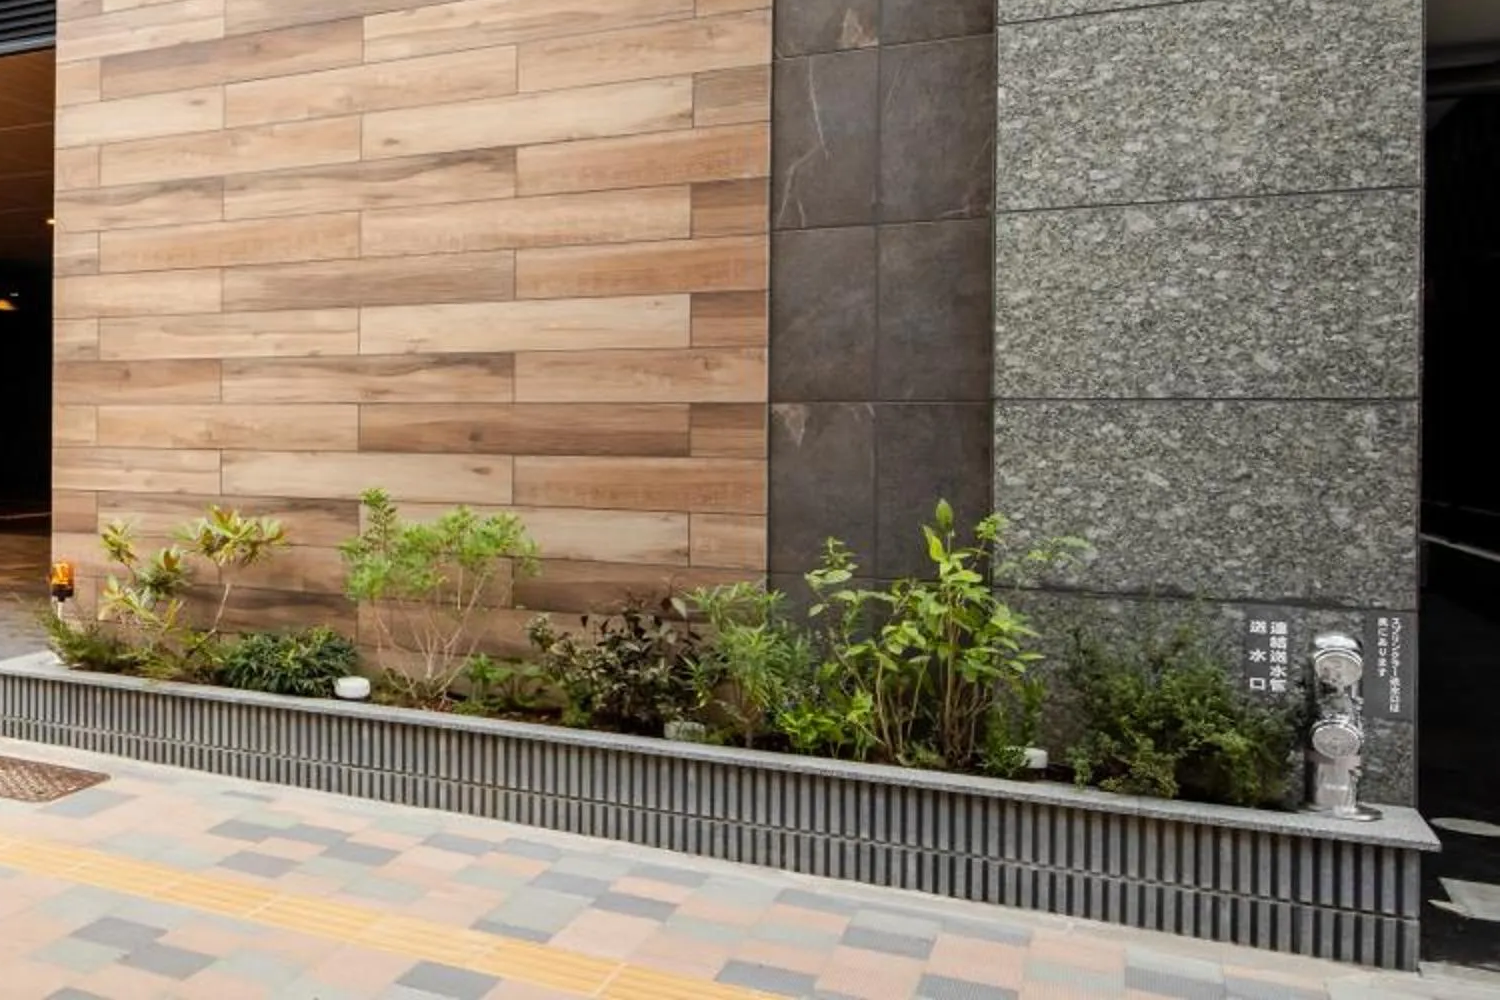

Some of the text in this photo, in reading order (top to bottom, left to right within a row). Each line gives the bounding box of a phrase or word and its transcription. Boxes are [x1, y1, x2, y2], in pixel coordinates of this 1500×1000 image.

[1248, 619, 1268, 691] 送水口
[1269, 620, 1288, 693] 連結送水管
